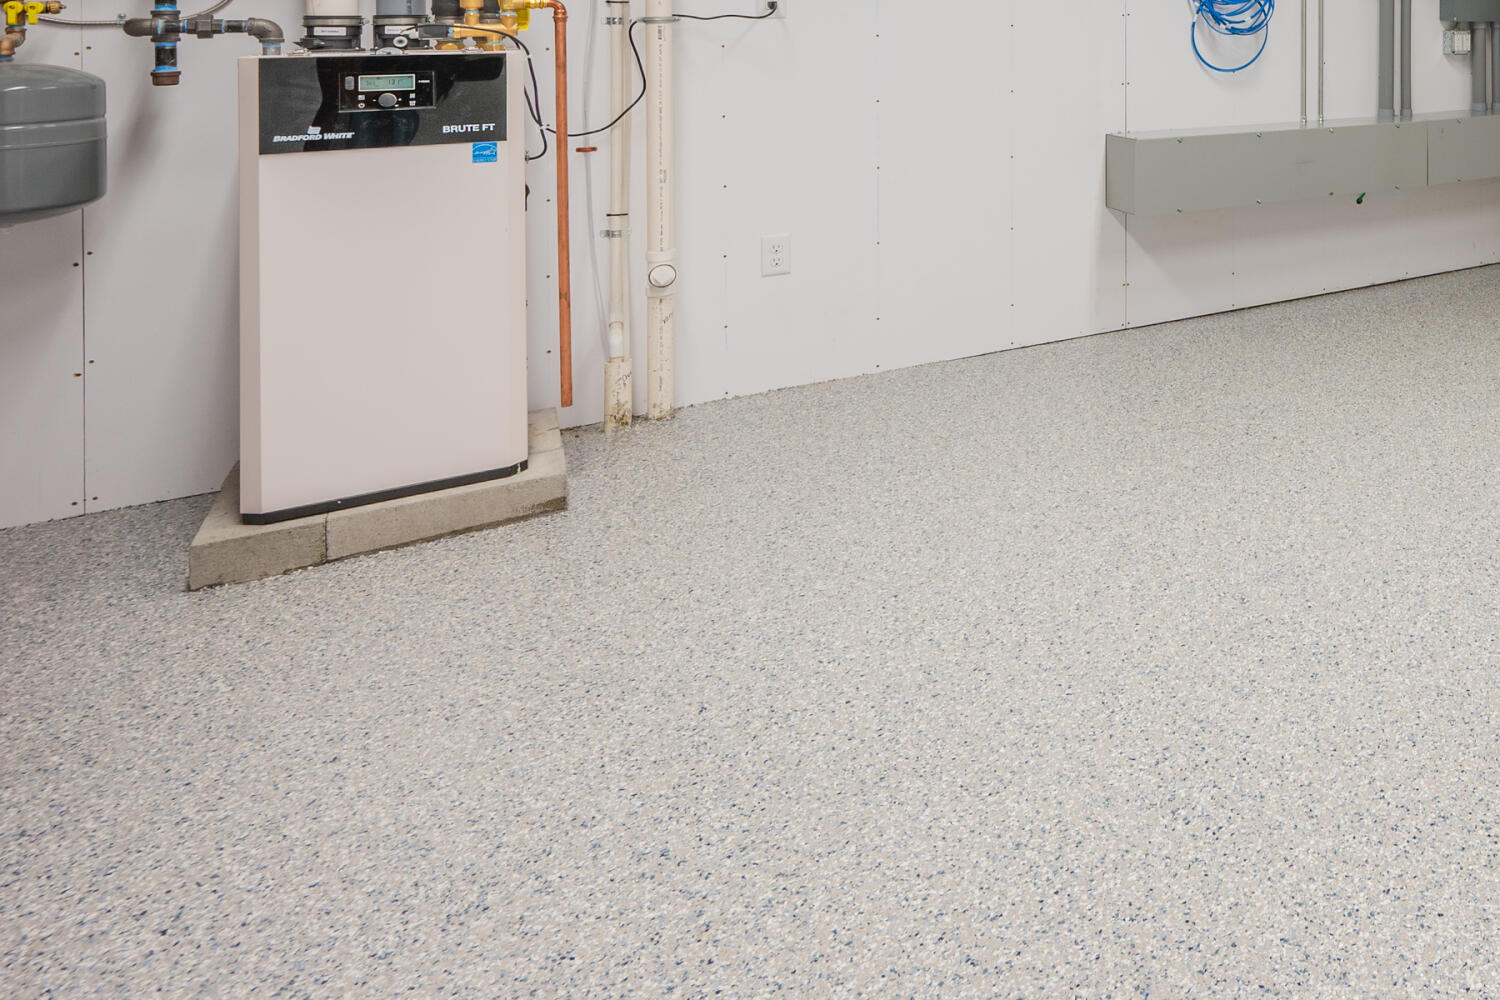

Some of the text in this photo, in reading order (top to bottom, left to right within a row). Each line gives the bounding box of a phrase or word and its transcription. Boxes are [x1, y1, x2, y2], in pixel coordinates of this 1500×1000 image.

[442, 123, 496, 134] BRUTE FT
[272, 131, 354, 143] BRADFORD WHITE
